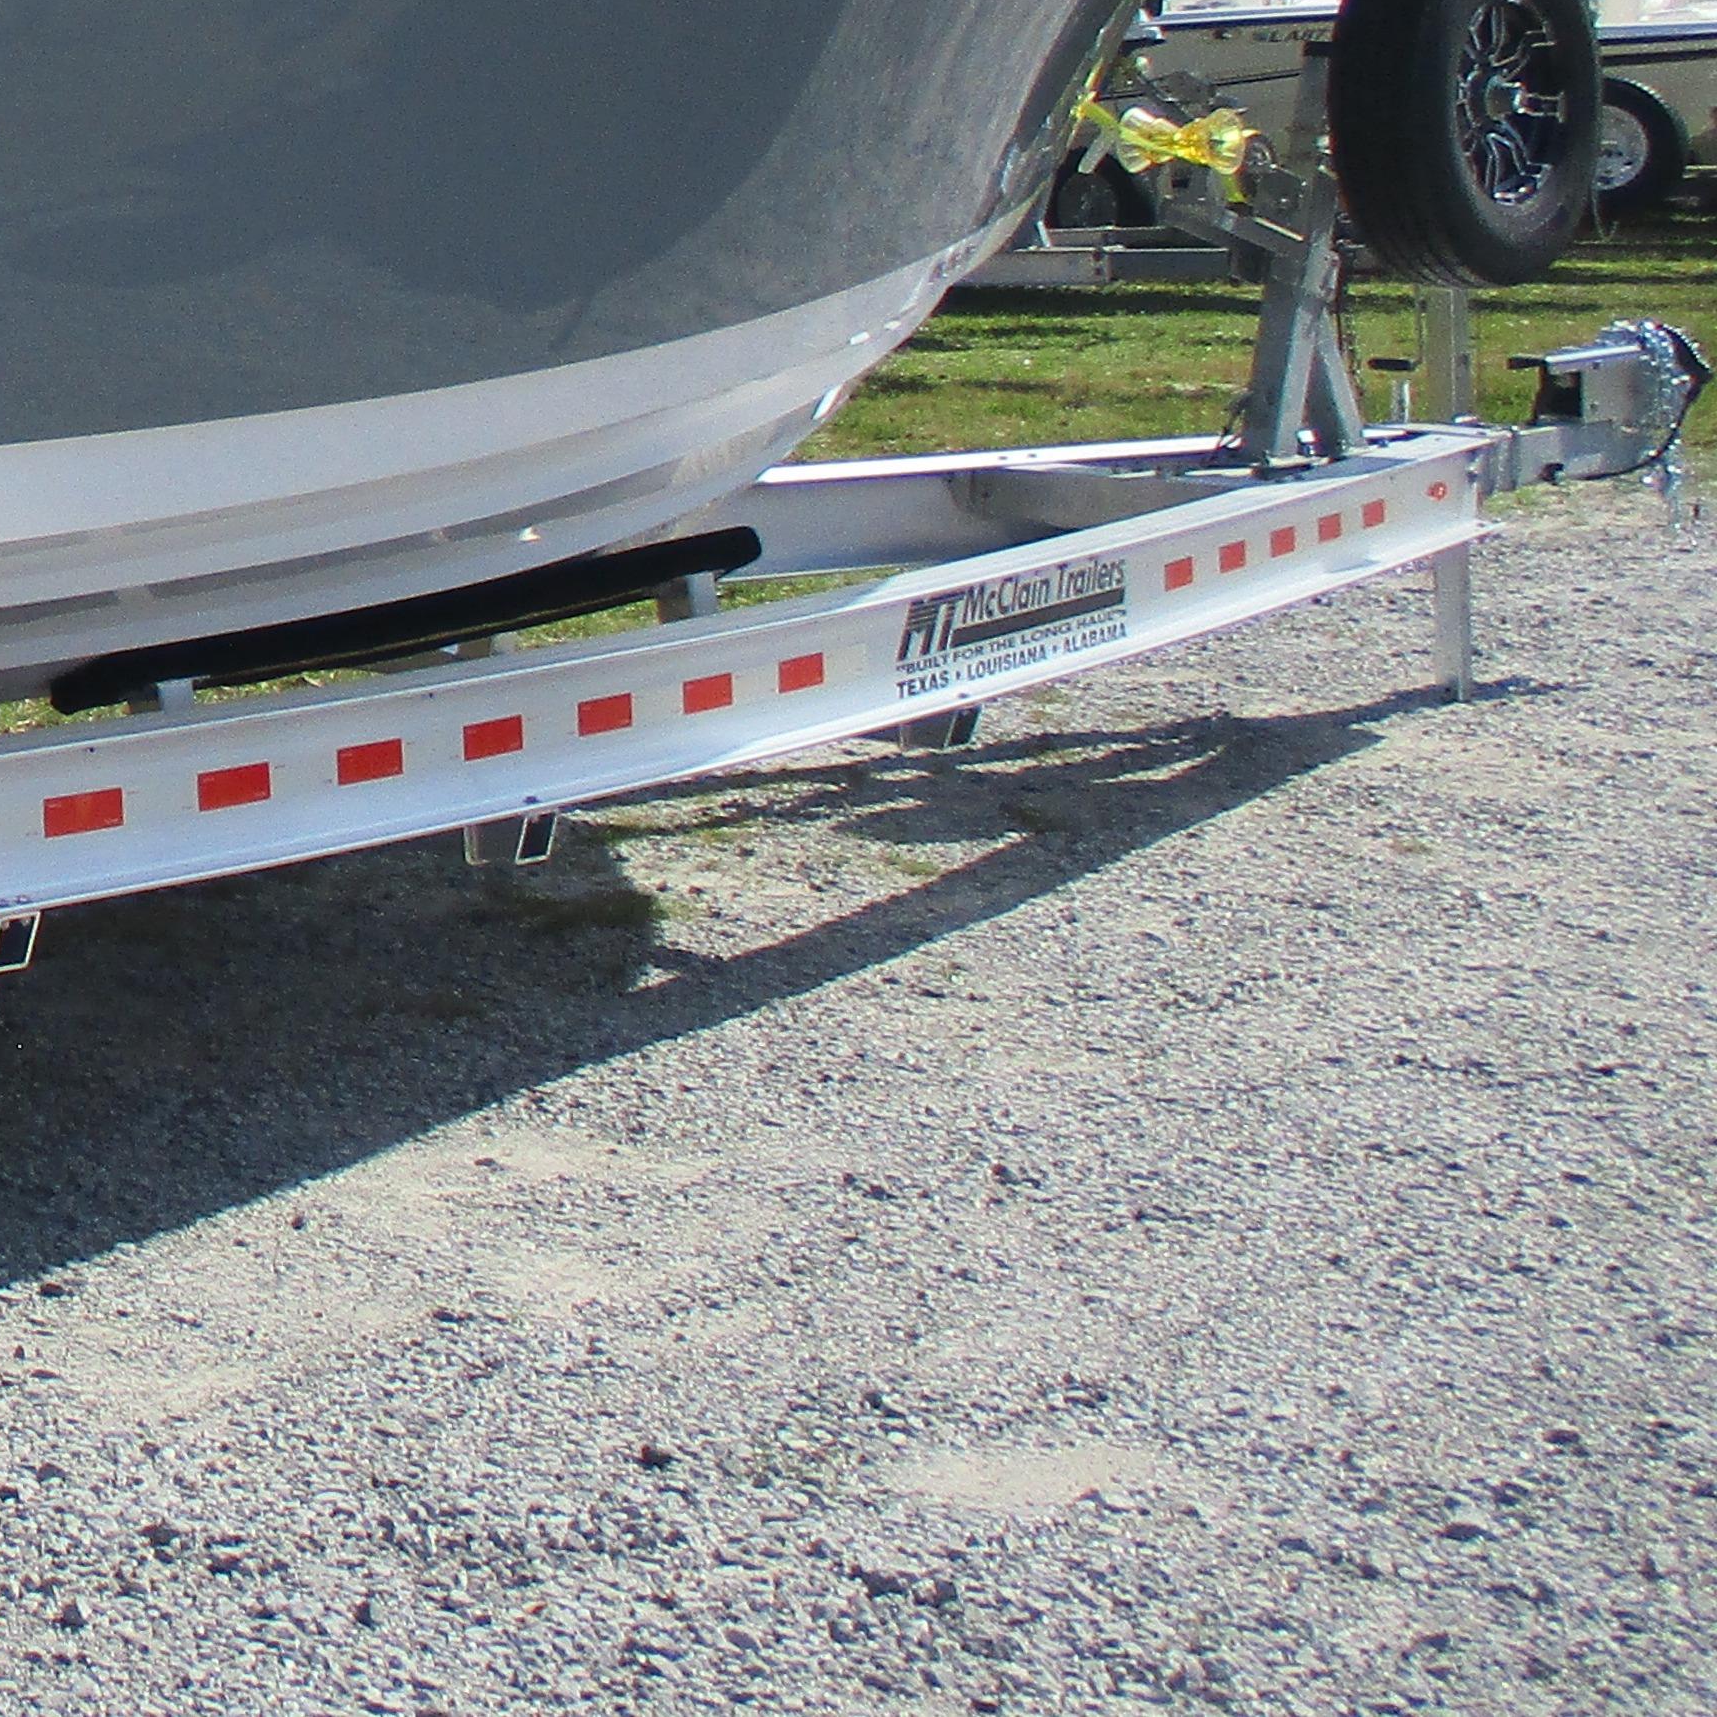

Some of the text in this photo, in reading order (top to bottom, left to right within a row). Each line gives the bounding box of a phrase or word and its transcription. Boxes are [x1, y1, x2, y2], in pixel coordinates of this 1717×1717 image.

[961, 557, 1126, 624] McClain Trailers
[896, 622, 1127, 699] TEXAS LOUISIANA ALABAMA
[953, 644, 984, 663] FOR
[989, 637, 1016, 654] THE
[1020, 622, 1073, 645] LONG
